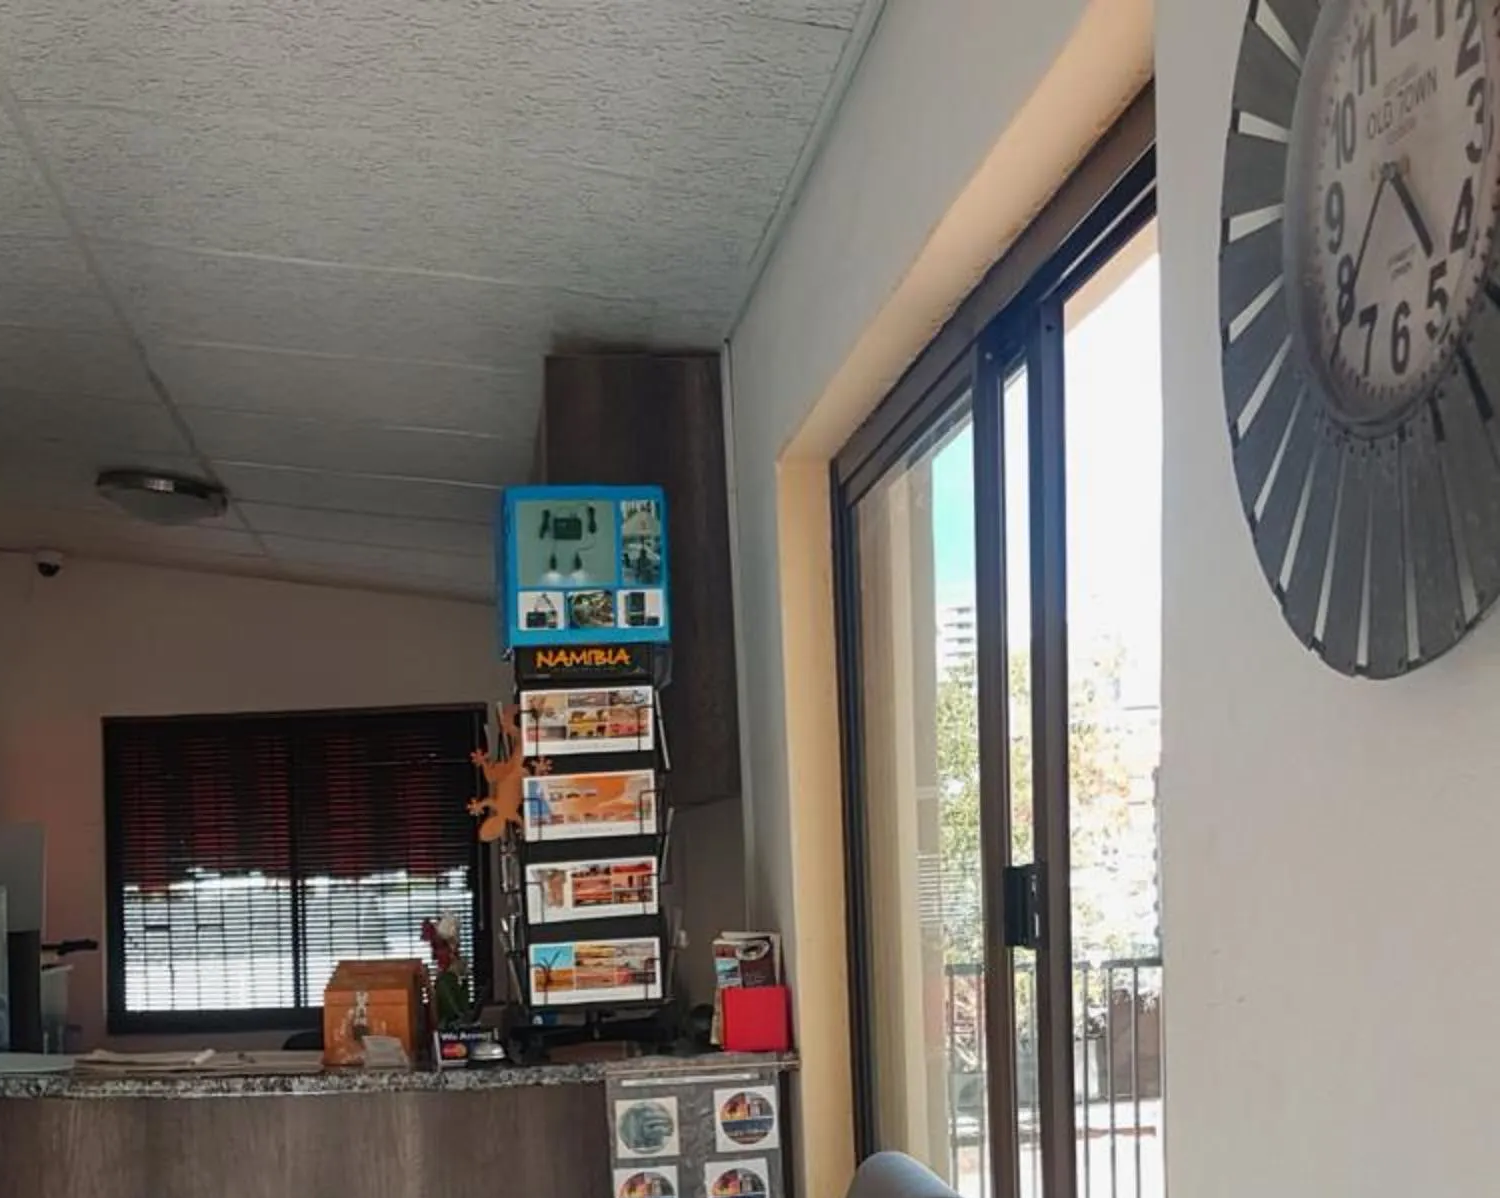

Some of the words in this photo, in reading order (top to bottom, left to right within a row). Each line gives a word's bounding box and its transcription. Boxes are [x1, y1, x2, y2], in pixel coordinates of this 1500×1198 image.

[1352, 12, 1377, 96] 11
[1455, 0, 1482, 79] 2
[1330, 91, 1357, 170] 10
[1367, 100, 1393, 140] OLD
[1396, 65, 1438, 118] TOWN
[1465, 77, 1487, 164] 3
[1325, 181, 1346, 254] 9
[1450, 175, 1474, 254] 4
[1336, 254, 1356, 327] 8
[1426, 259, 1448, 341] 5
[1358, 303, 1379, 378] 7
[1391, 300, 1411, 377] 6
[535, 647, 631, 669] NAMIBIA
